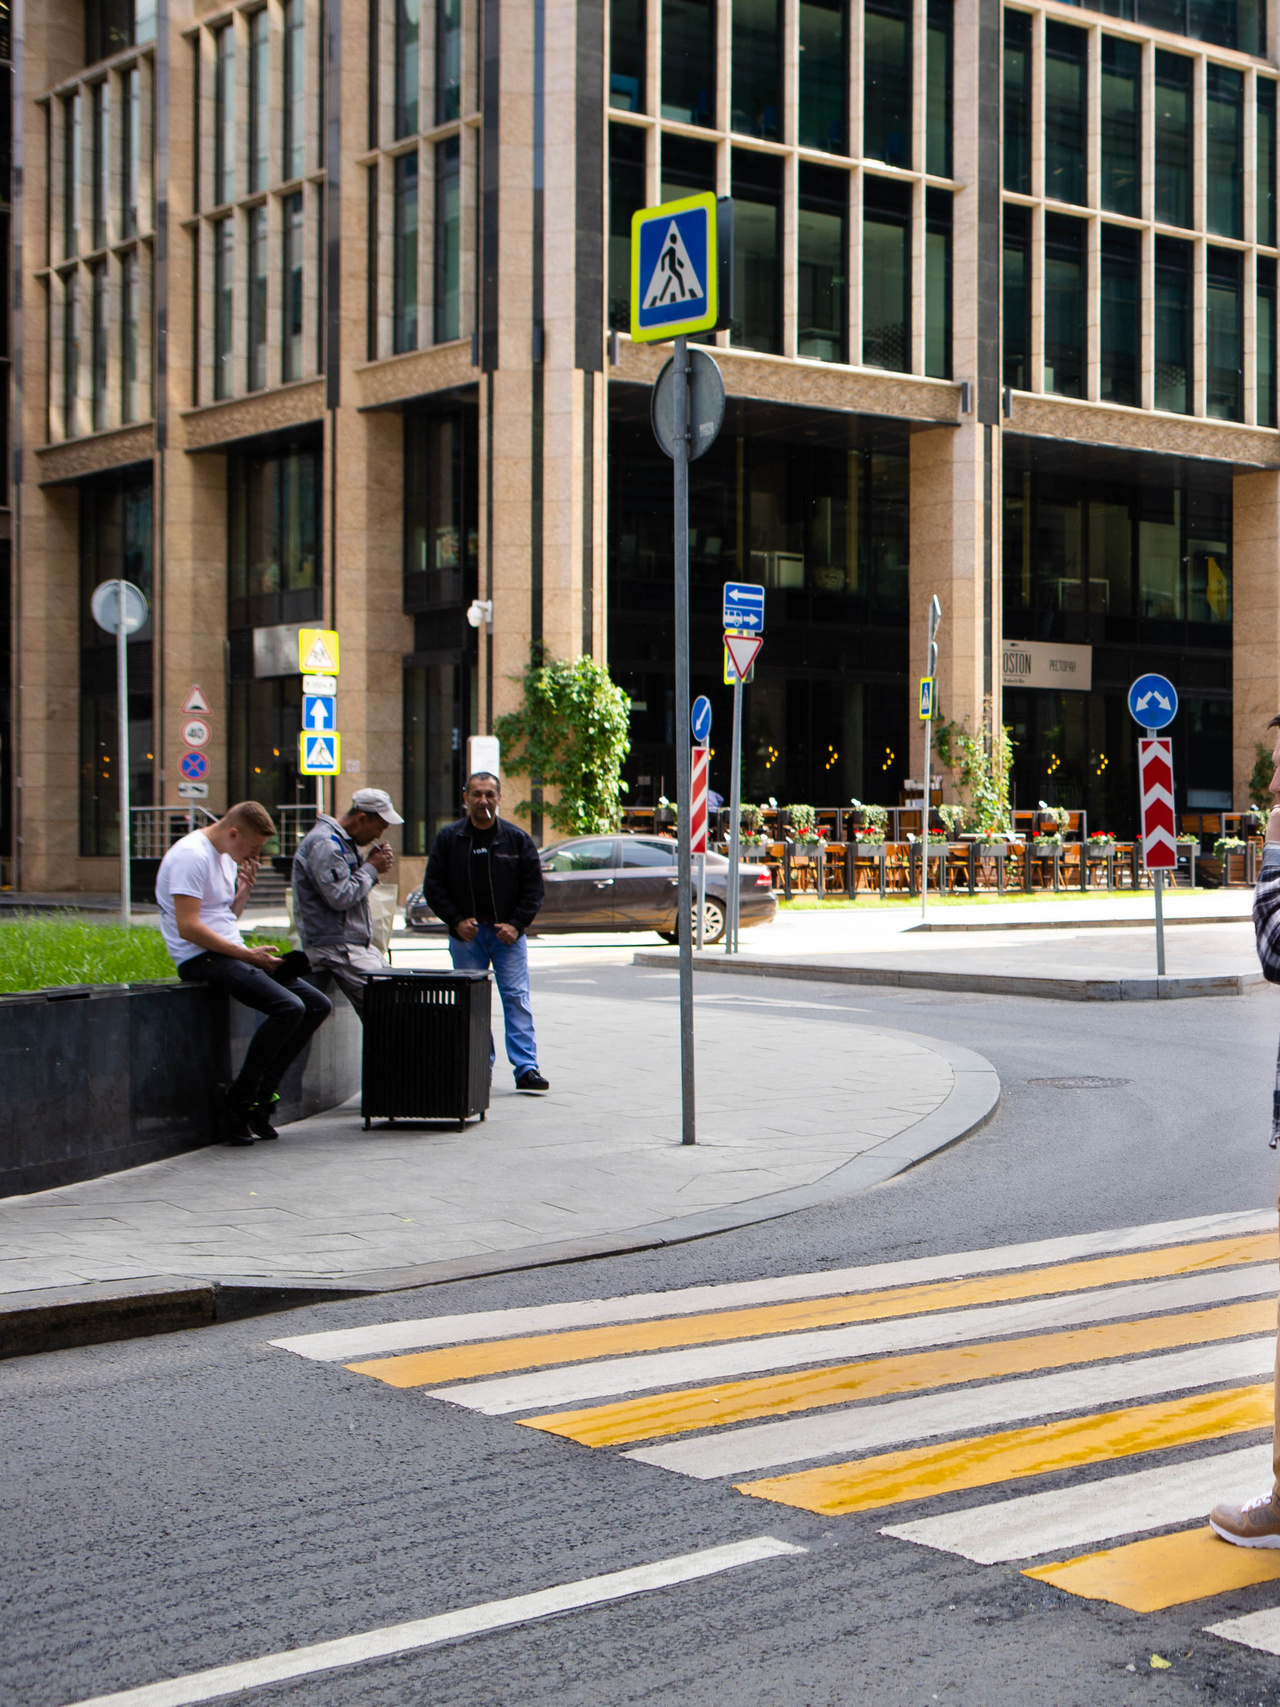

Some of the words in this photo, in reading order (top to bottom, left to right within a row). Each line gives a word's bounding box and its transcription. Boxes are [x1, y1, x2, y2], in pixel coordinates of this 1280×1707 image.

[1002, 652, 1031, 675] OSTON
[1049, 659, 1077, 673] РЕСТОРАН
[187, 727, 205, 740] 40
